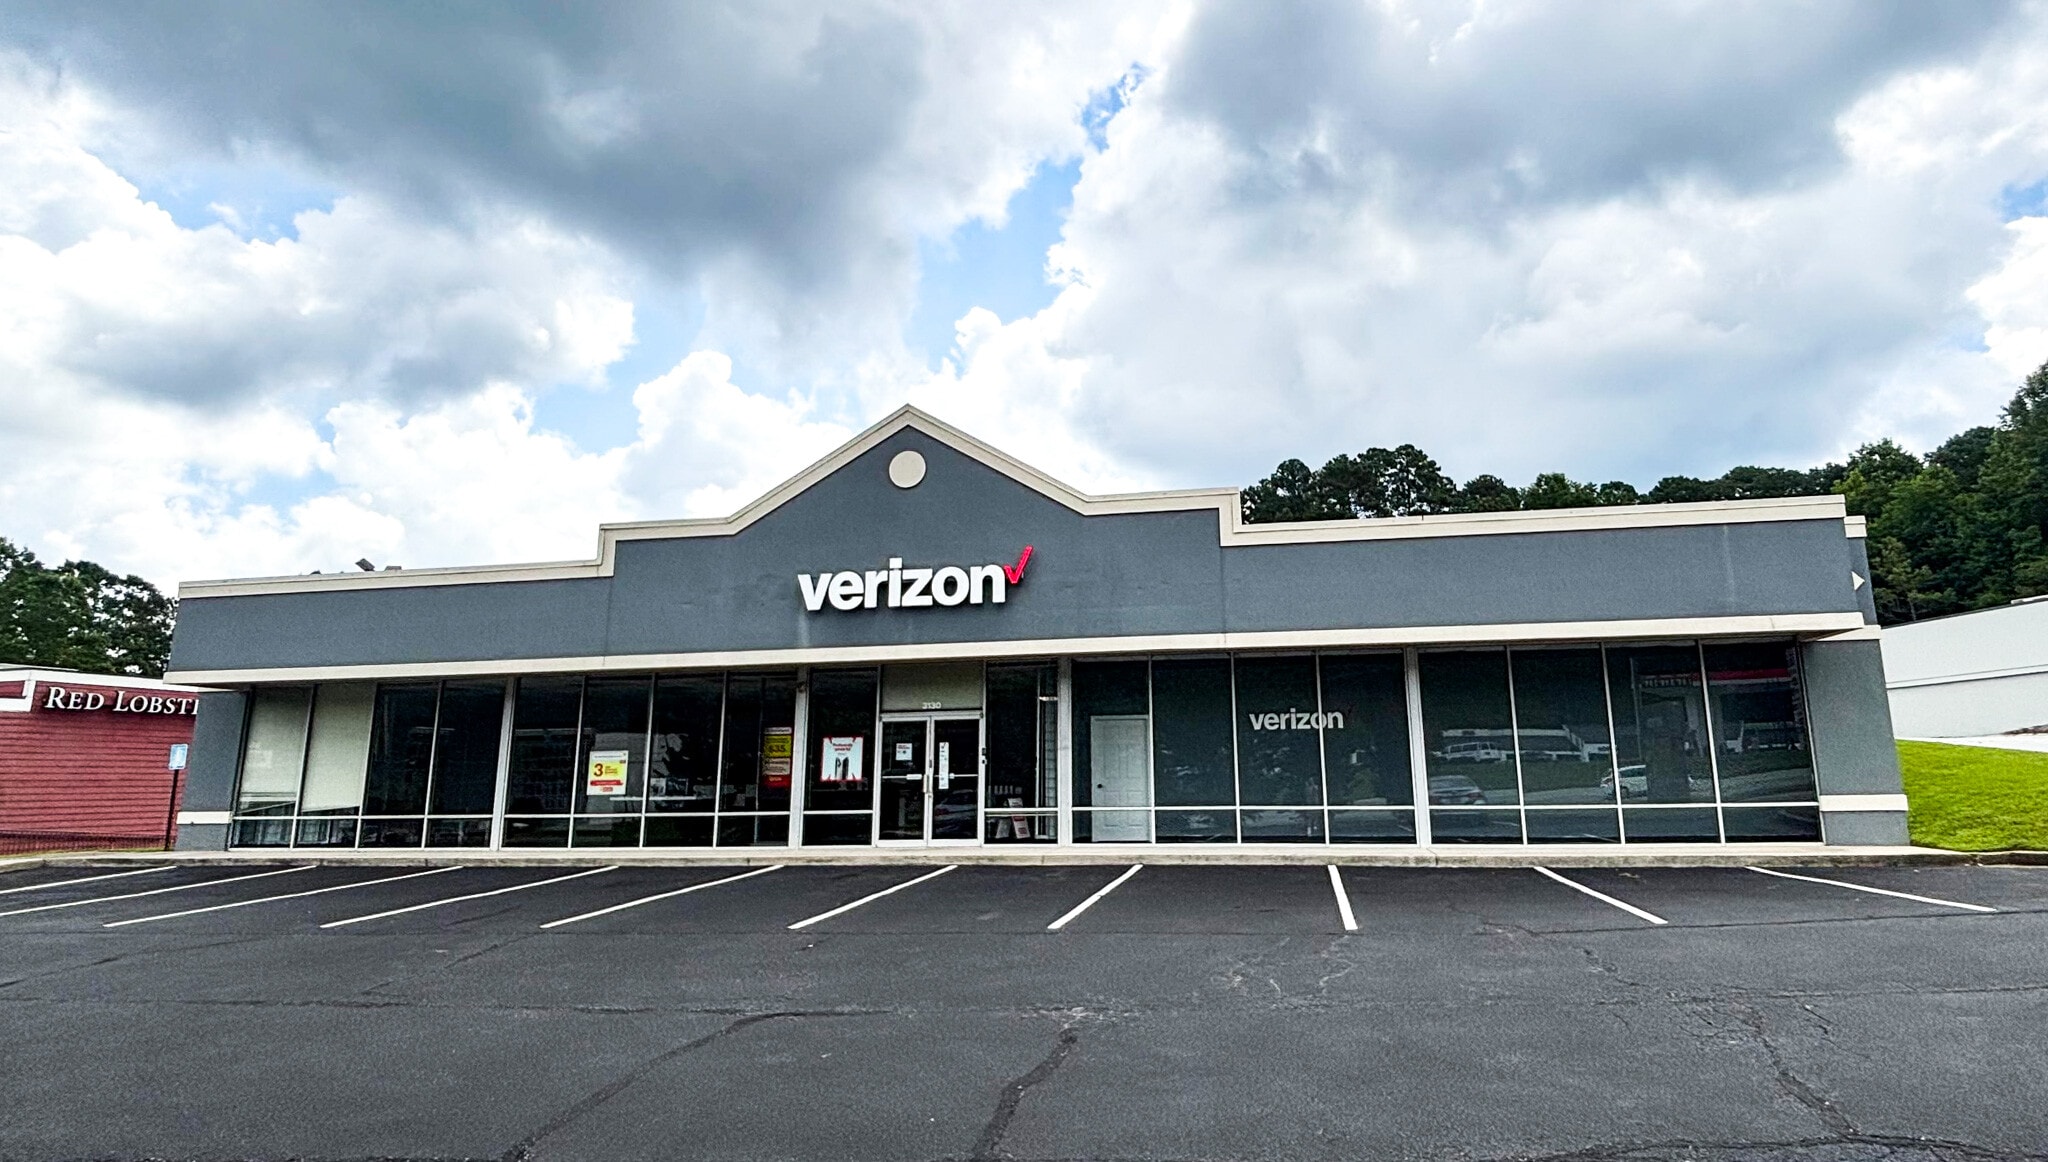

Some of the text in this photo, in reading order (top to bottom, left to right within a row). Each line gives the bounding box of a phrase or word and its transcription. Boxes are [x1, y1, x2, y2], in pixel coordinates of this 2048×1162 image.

[798, 557, 1006, 611] verizon
[45, 687, 104, 710] RED
[1249, 708, 1344, 731] verizon
[593, 763, 604, 777] 3
